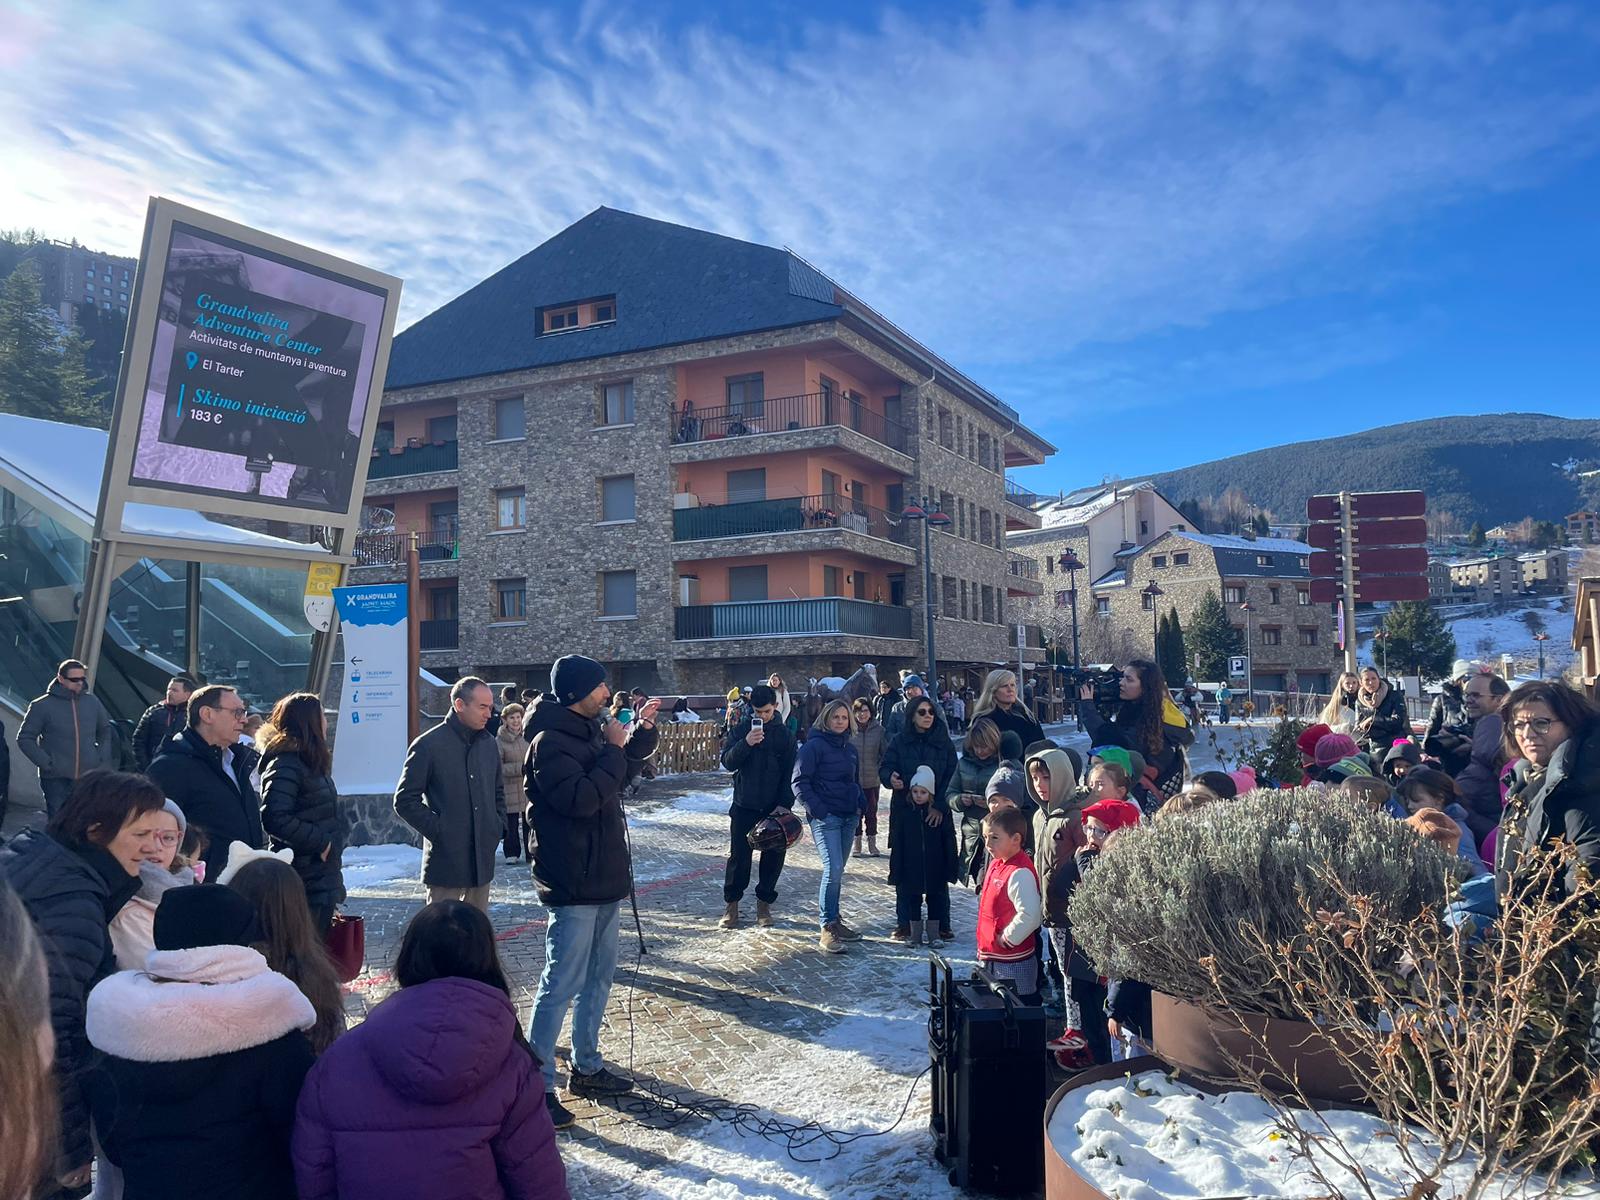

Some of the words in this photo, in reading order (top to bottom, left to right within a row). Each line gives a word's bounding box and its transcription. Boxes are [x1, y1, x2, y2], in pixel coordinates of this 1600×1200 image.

[196, 292, 289, 330] Grandvalira
[193, 312, 271, 343] Adventure
[274, 333, 322, 355] Center
[189, 329, 238, 351] Activitats
[240, 342, 253, 354] de
[254, 348, 302, 366] muntanya
[308, 361, 347, 377] aventura
[202, 359, 213, 371] El
[215, 361, 245, 377] Tarter
[190, 409, 211, 423] 183
[213, 414, 223, 424] €
[192, 388, 241, 411] Skimo
[244, 400, 306, 424] iniciació
[356, 592, 397, 601] GRANDVALIRA
